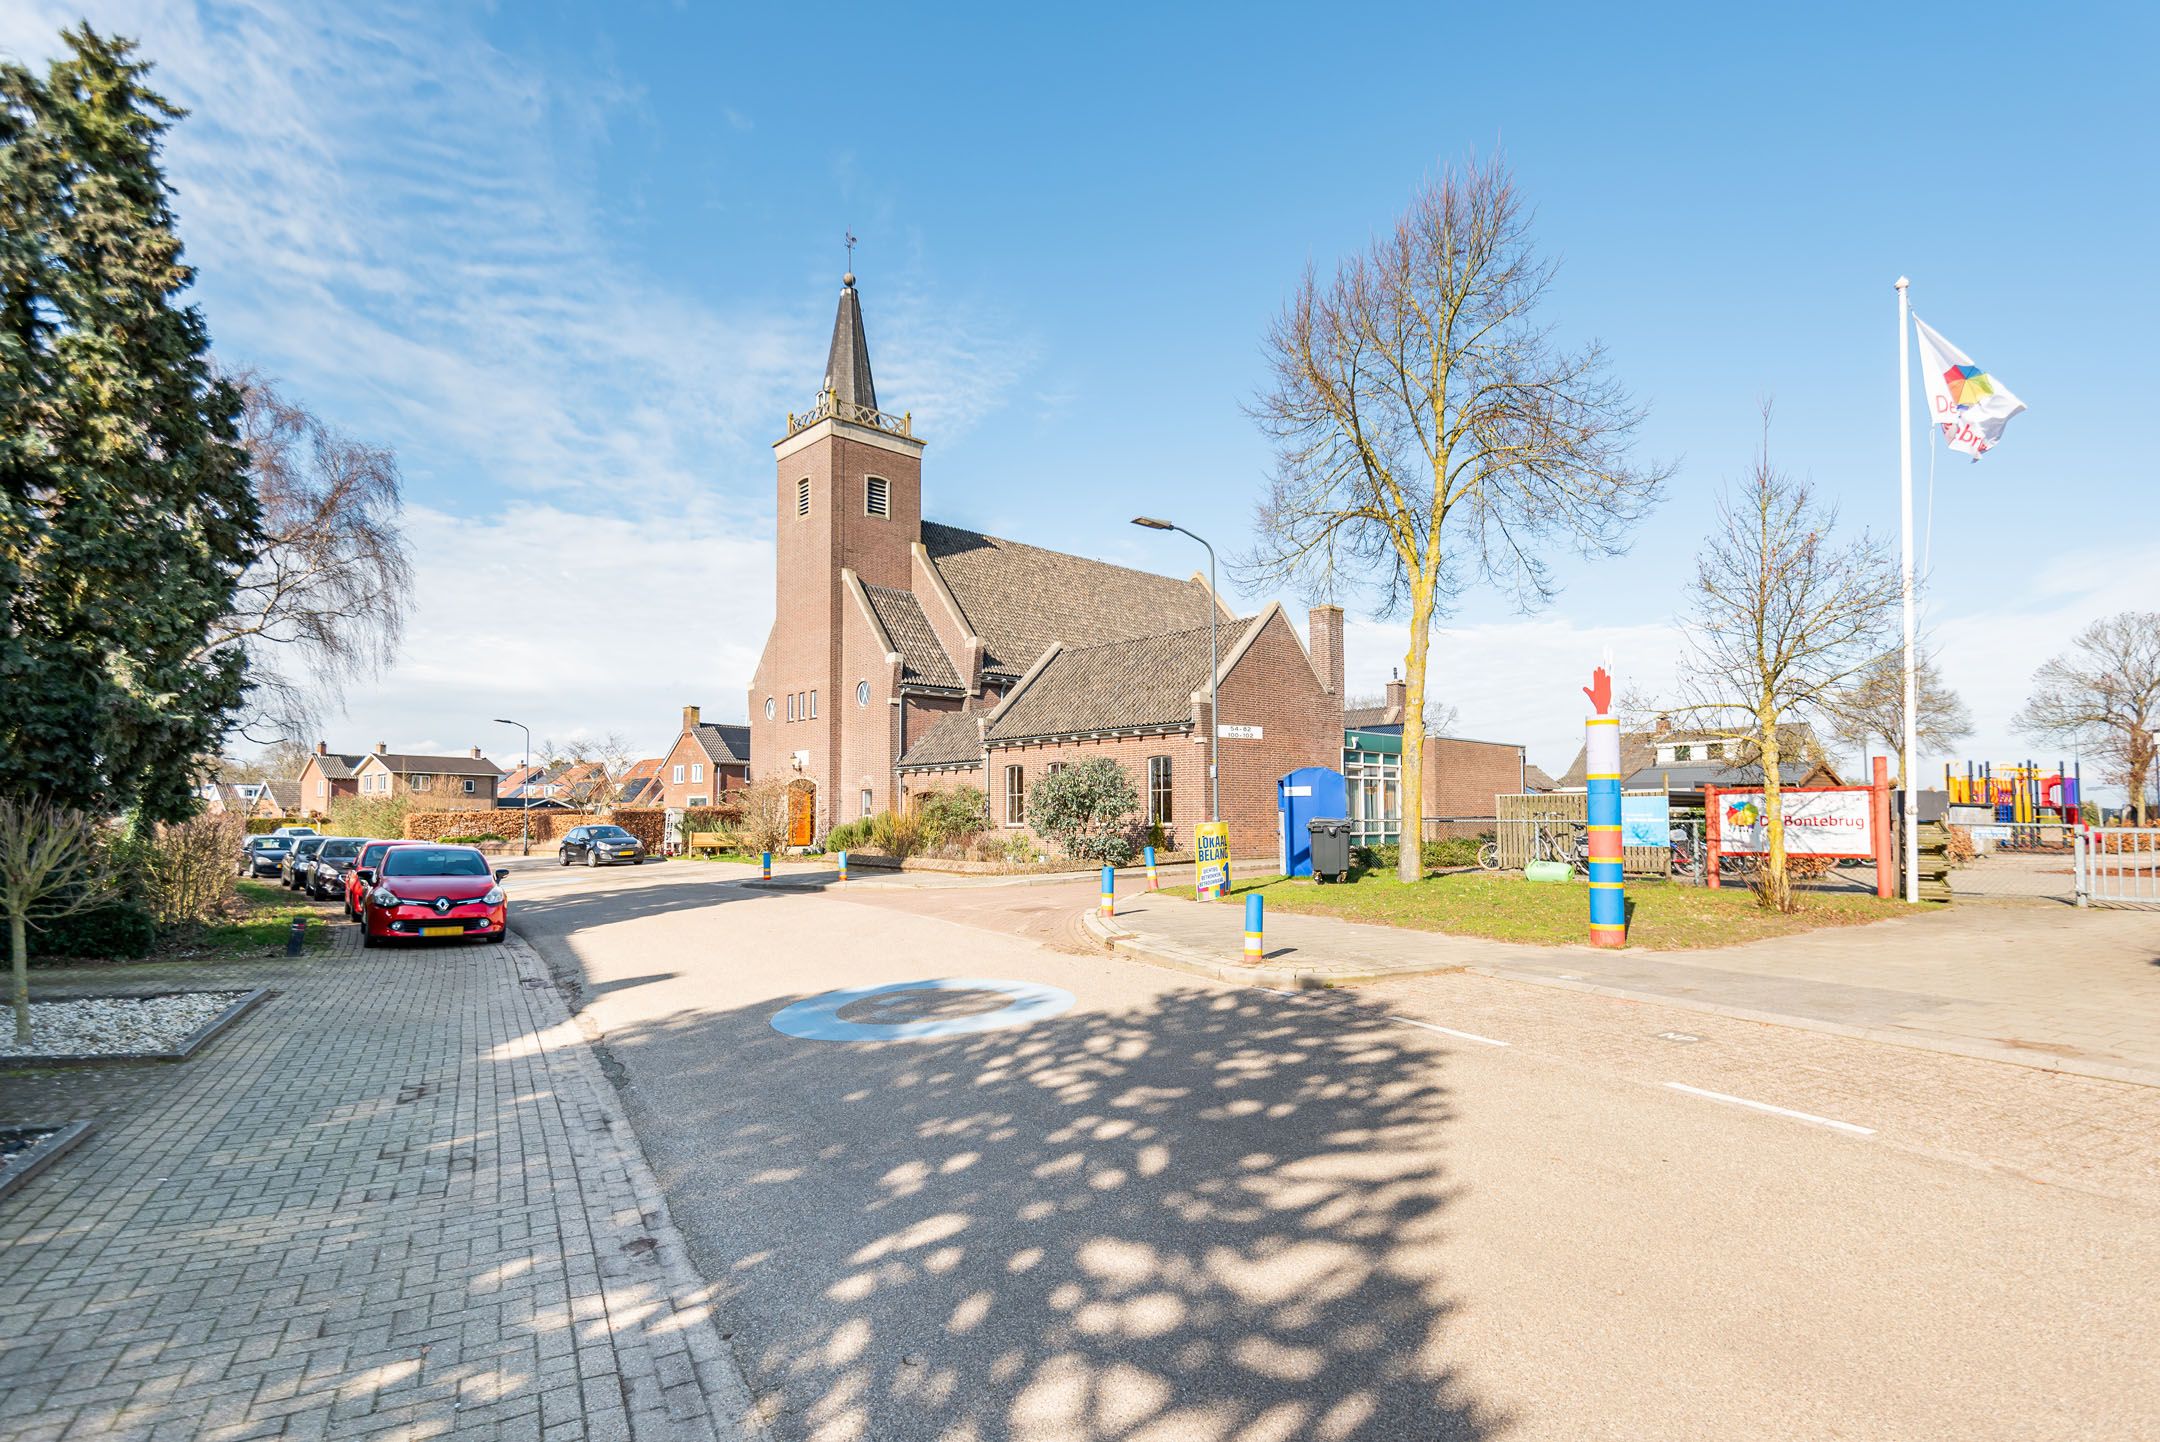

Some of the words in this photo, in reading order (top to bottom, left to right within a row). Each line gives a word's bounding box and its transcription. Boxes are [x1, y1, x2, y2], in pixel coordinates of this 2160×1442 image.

[1784, 815, 1864, 830] Bontebrug
[1198, 835, 1227, 849] LOKAAL
[1198, 847, 1228, 862] BELANG
